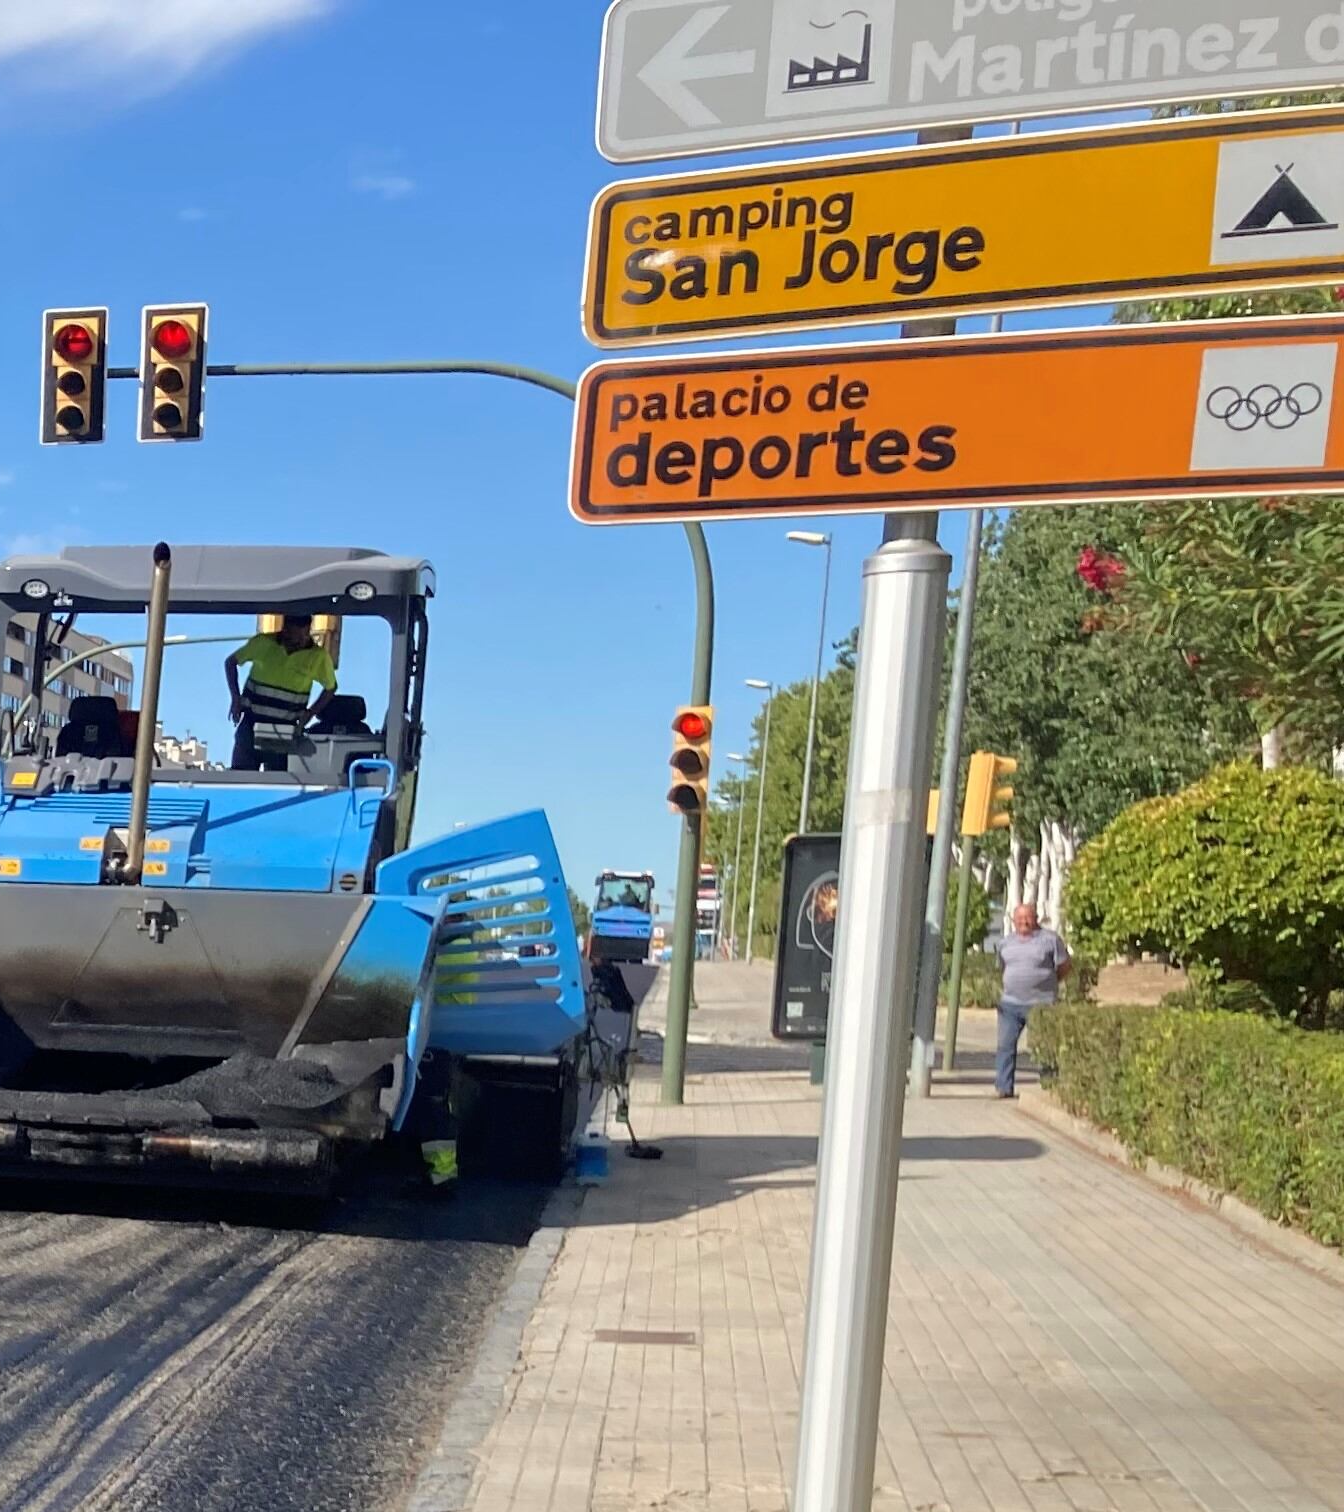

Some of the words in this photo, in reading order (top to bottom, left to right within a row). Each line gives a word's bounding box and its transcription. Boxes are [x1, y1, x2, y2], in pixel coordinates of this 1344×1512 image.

[909, 14, 1280, 102] Martínez
[624, 188, 855, 244] camping
[621, 248, 759, 305] San
[783, 226, 986, 295] Jorge
[609, 375, 792, 432] palacio
[806, 374, 870, 412] de
[606, 417, 958, 498] deportes
